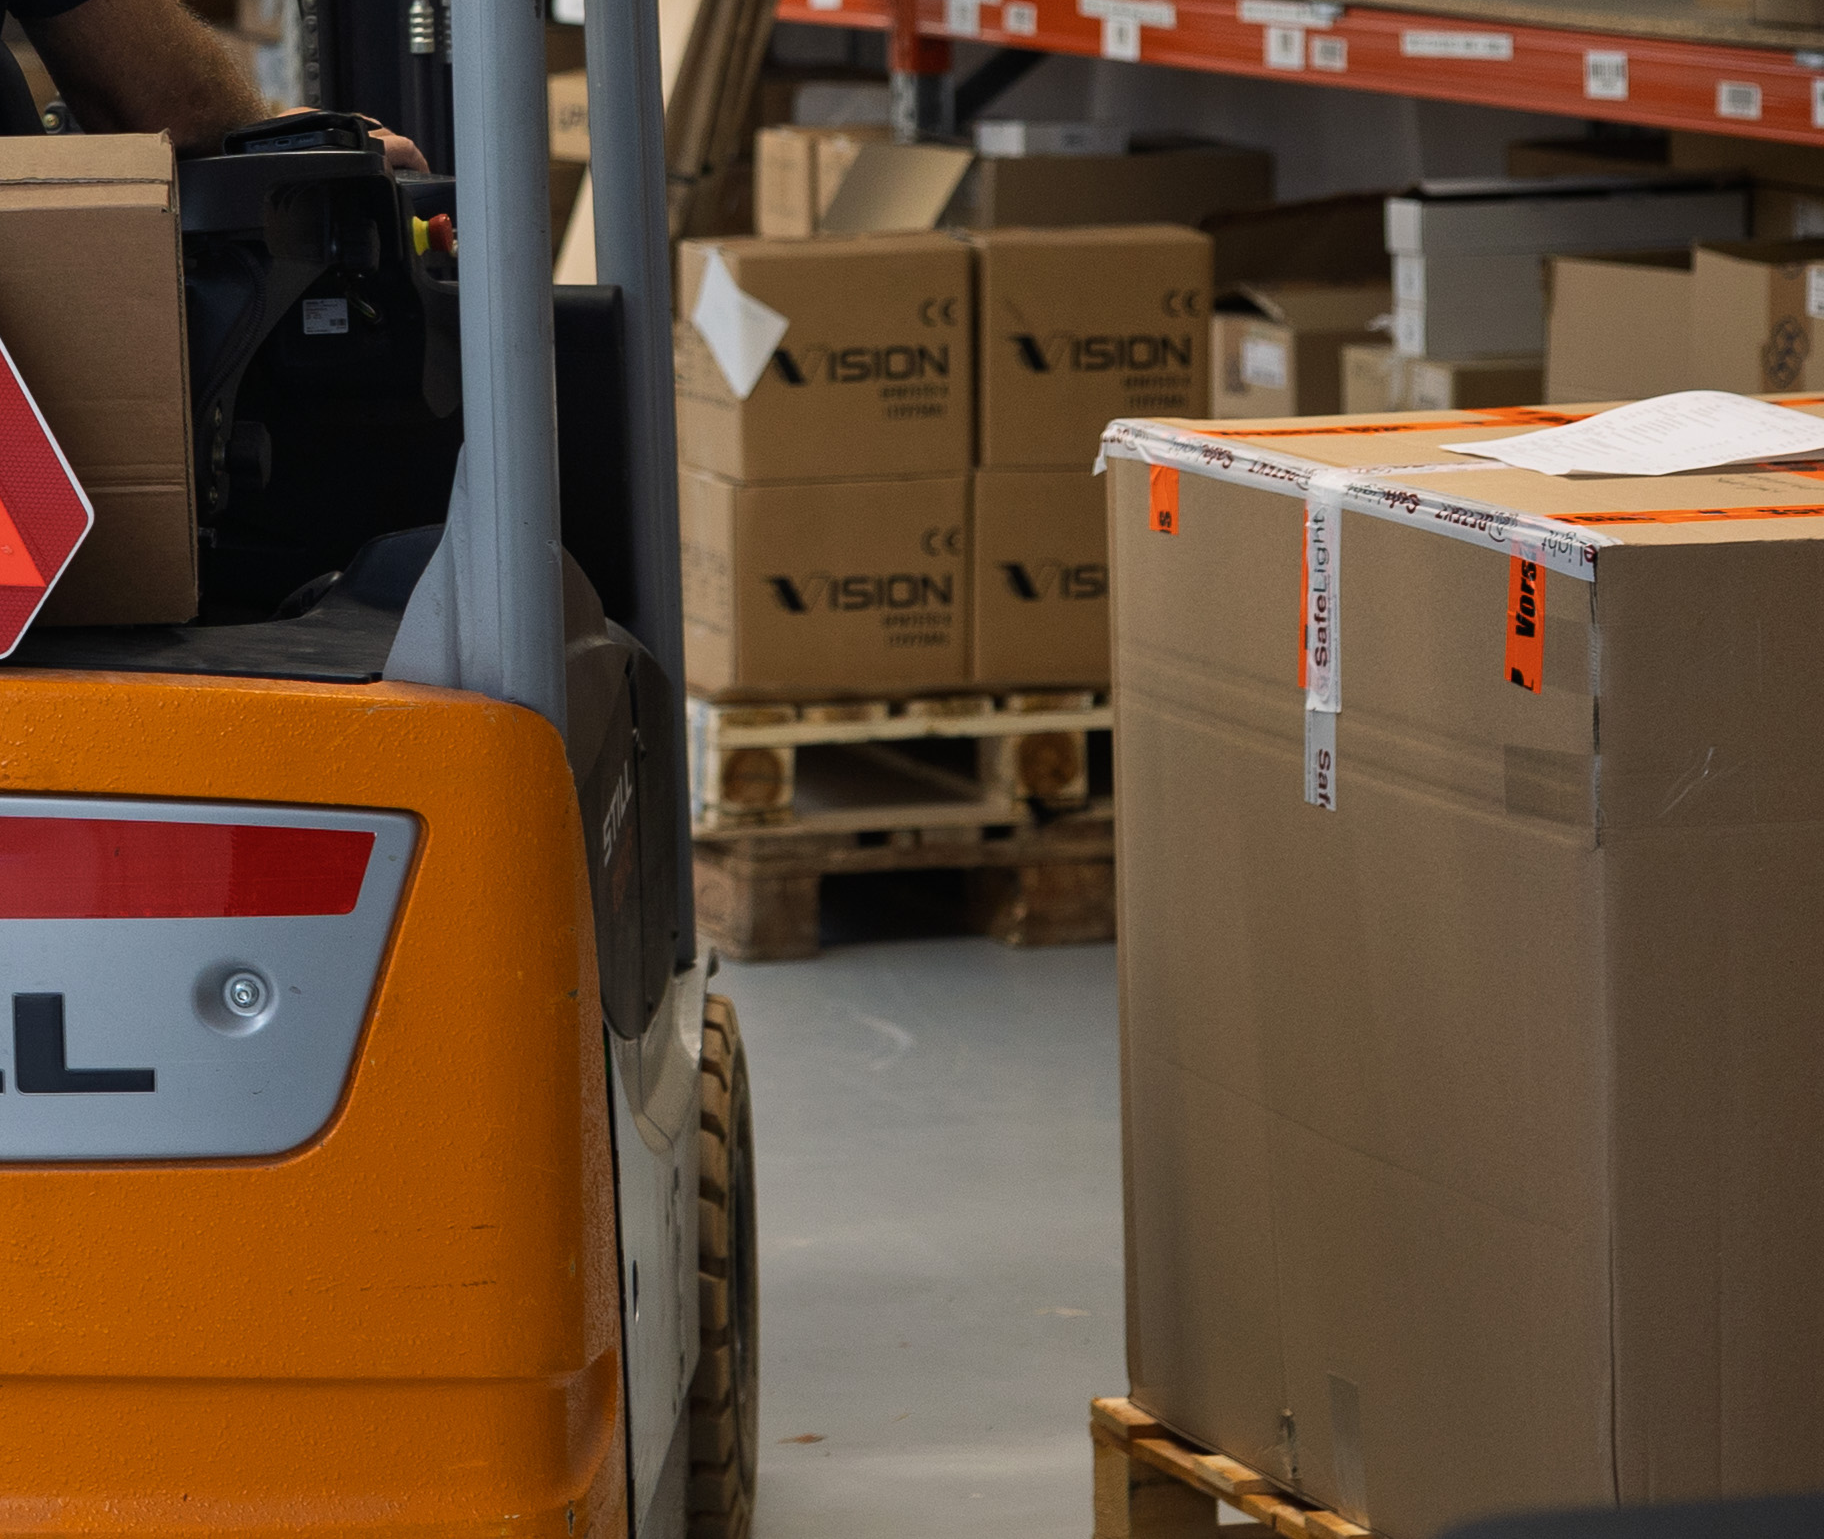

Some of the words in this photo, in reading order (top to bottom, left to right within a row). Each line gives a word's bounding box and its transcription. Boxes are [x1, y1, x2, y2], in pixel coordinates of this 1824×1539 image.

[1007, 329, 1193, 375] VISION
[762, 568, 952, 616] VISION
[1313, 515, 1330, 668] SafeLight
[602, 759, 633, 869] STILL
